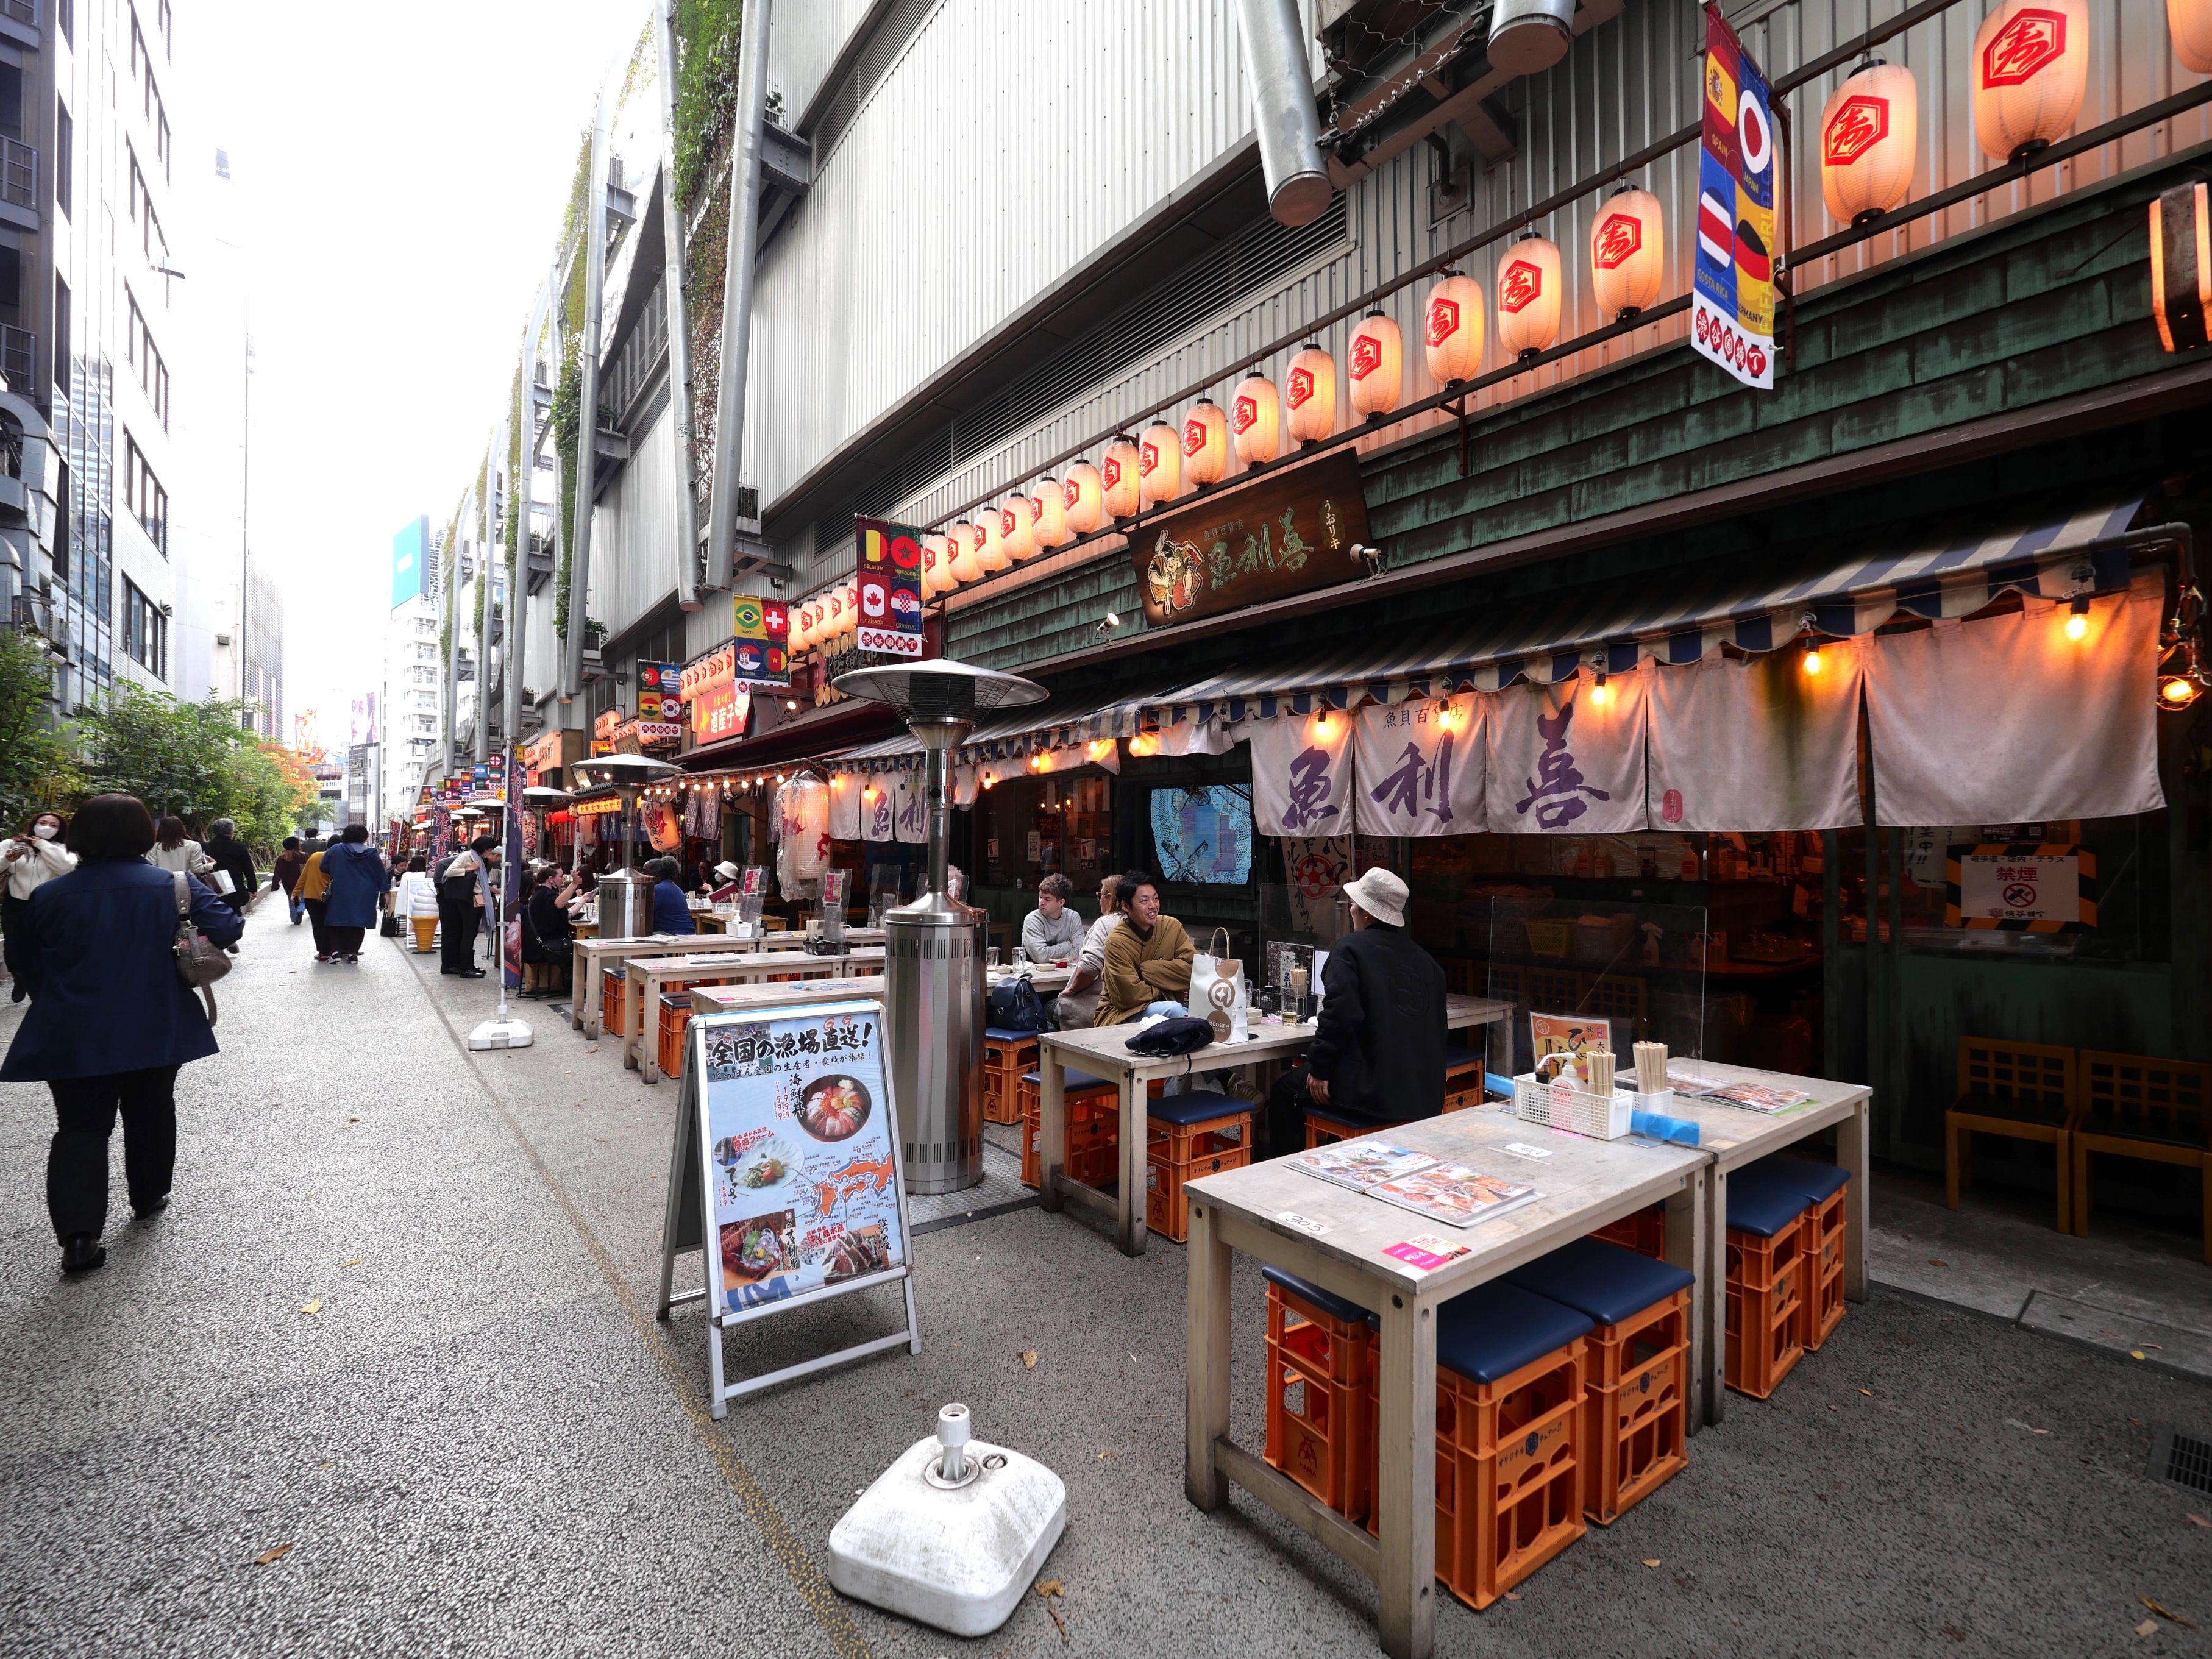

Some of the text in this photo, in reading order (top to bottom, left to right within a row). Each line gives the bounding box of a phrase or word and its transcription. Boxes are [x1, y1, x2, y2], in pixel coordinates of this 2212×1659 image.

[1712, 133, 1728, 158] SPAIN
[1743, 171, 1759, 194] JAPAN
[1698, 269, 1729, 300] COSTA RICA
[1736, 301, 1763, 324] GERMANY
[1203, 519, 1243, 541] 魚貝百貨店
[894, 568, 916, 577] MOROCCO
[1996, 866, 2038, 882] 禁煙
[1208, 1020, 1229, 1029] @cosme
[711, 1022, 872, 1067] 全国の漁場直送!
[789, 1073, 805, 1118] 海鮮丼
[1285, 1215, 1325, 1232] 303
